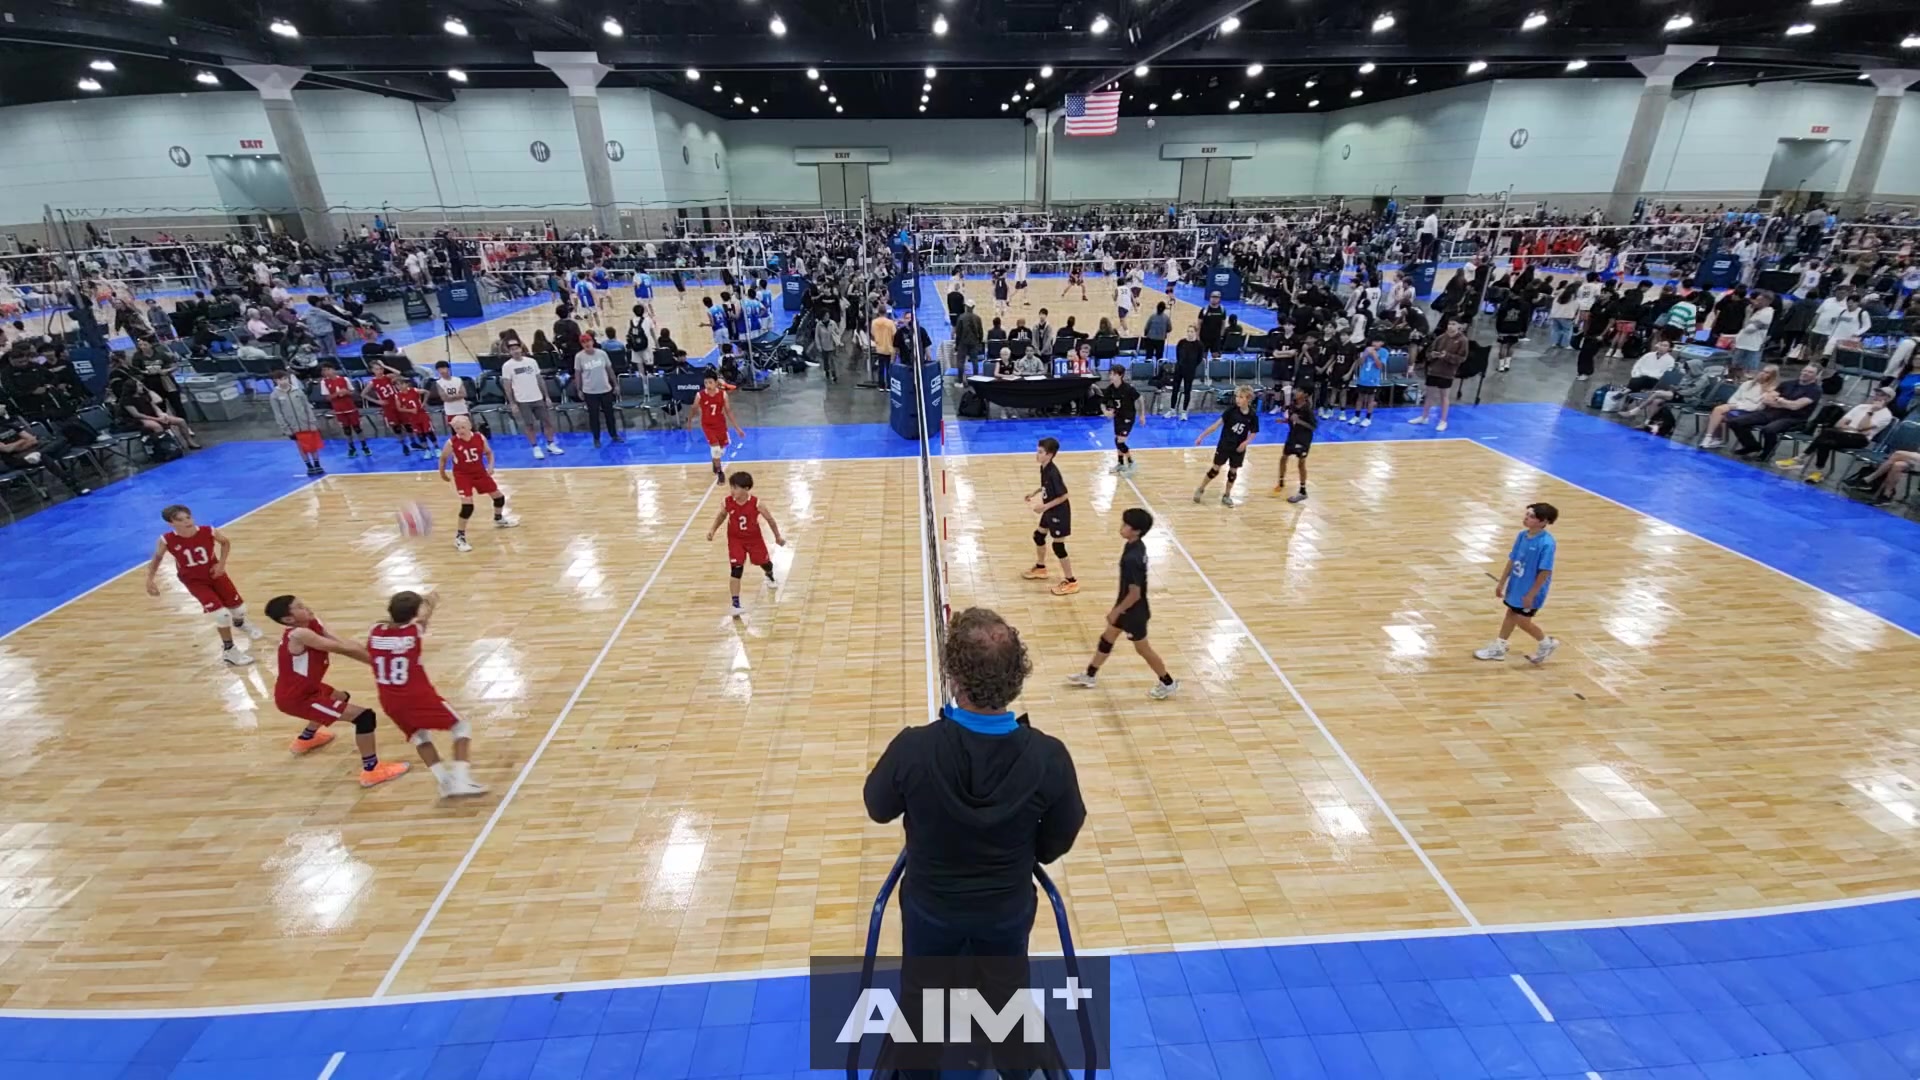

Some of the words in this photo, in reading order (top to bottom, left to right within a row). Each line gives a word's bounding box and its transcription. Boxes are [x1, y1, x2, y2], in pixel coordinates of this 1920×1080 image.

[1811, 125, 1830, 134] EXIT
[240, 139, 263, 149] EXIT
[1201, 146, 1217, 154] EXIT
[924, 234, 933, 242] 25
[1200, 228, 1209, 236] 25
[465, 240, 476, 249] 24
[1055, 361, 1068, 375] 18
[1073, 361, 1087, 375] 24
[710, 404, 717, 416] 7
[1231, 422, 1246, 435] 45
[463, 447, 479, 463] 15
[738, 515, 748, 531] 2
[183, 546, 209, 568] 13
[375, 656, 409, 685] 18
